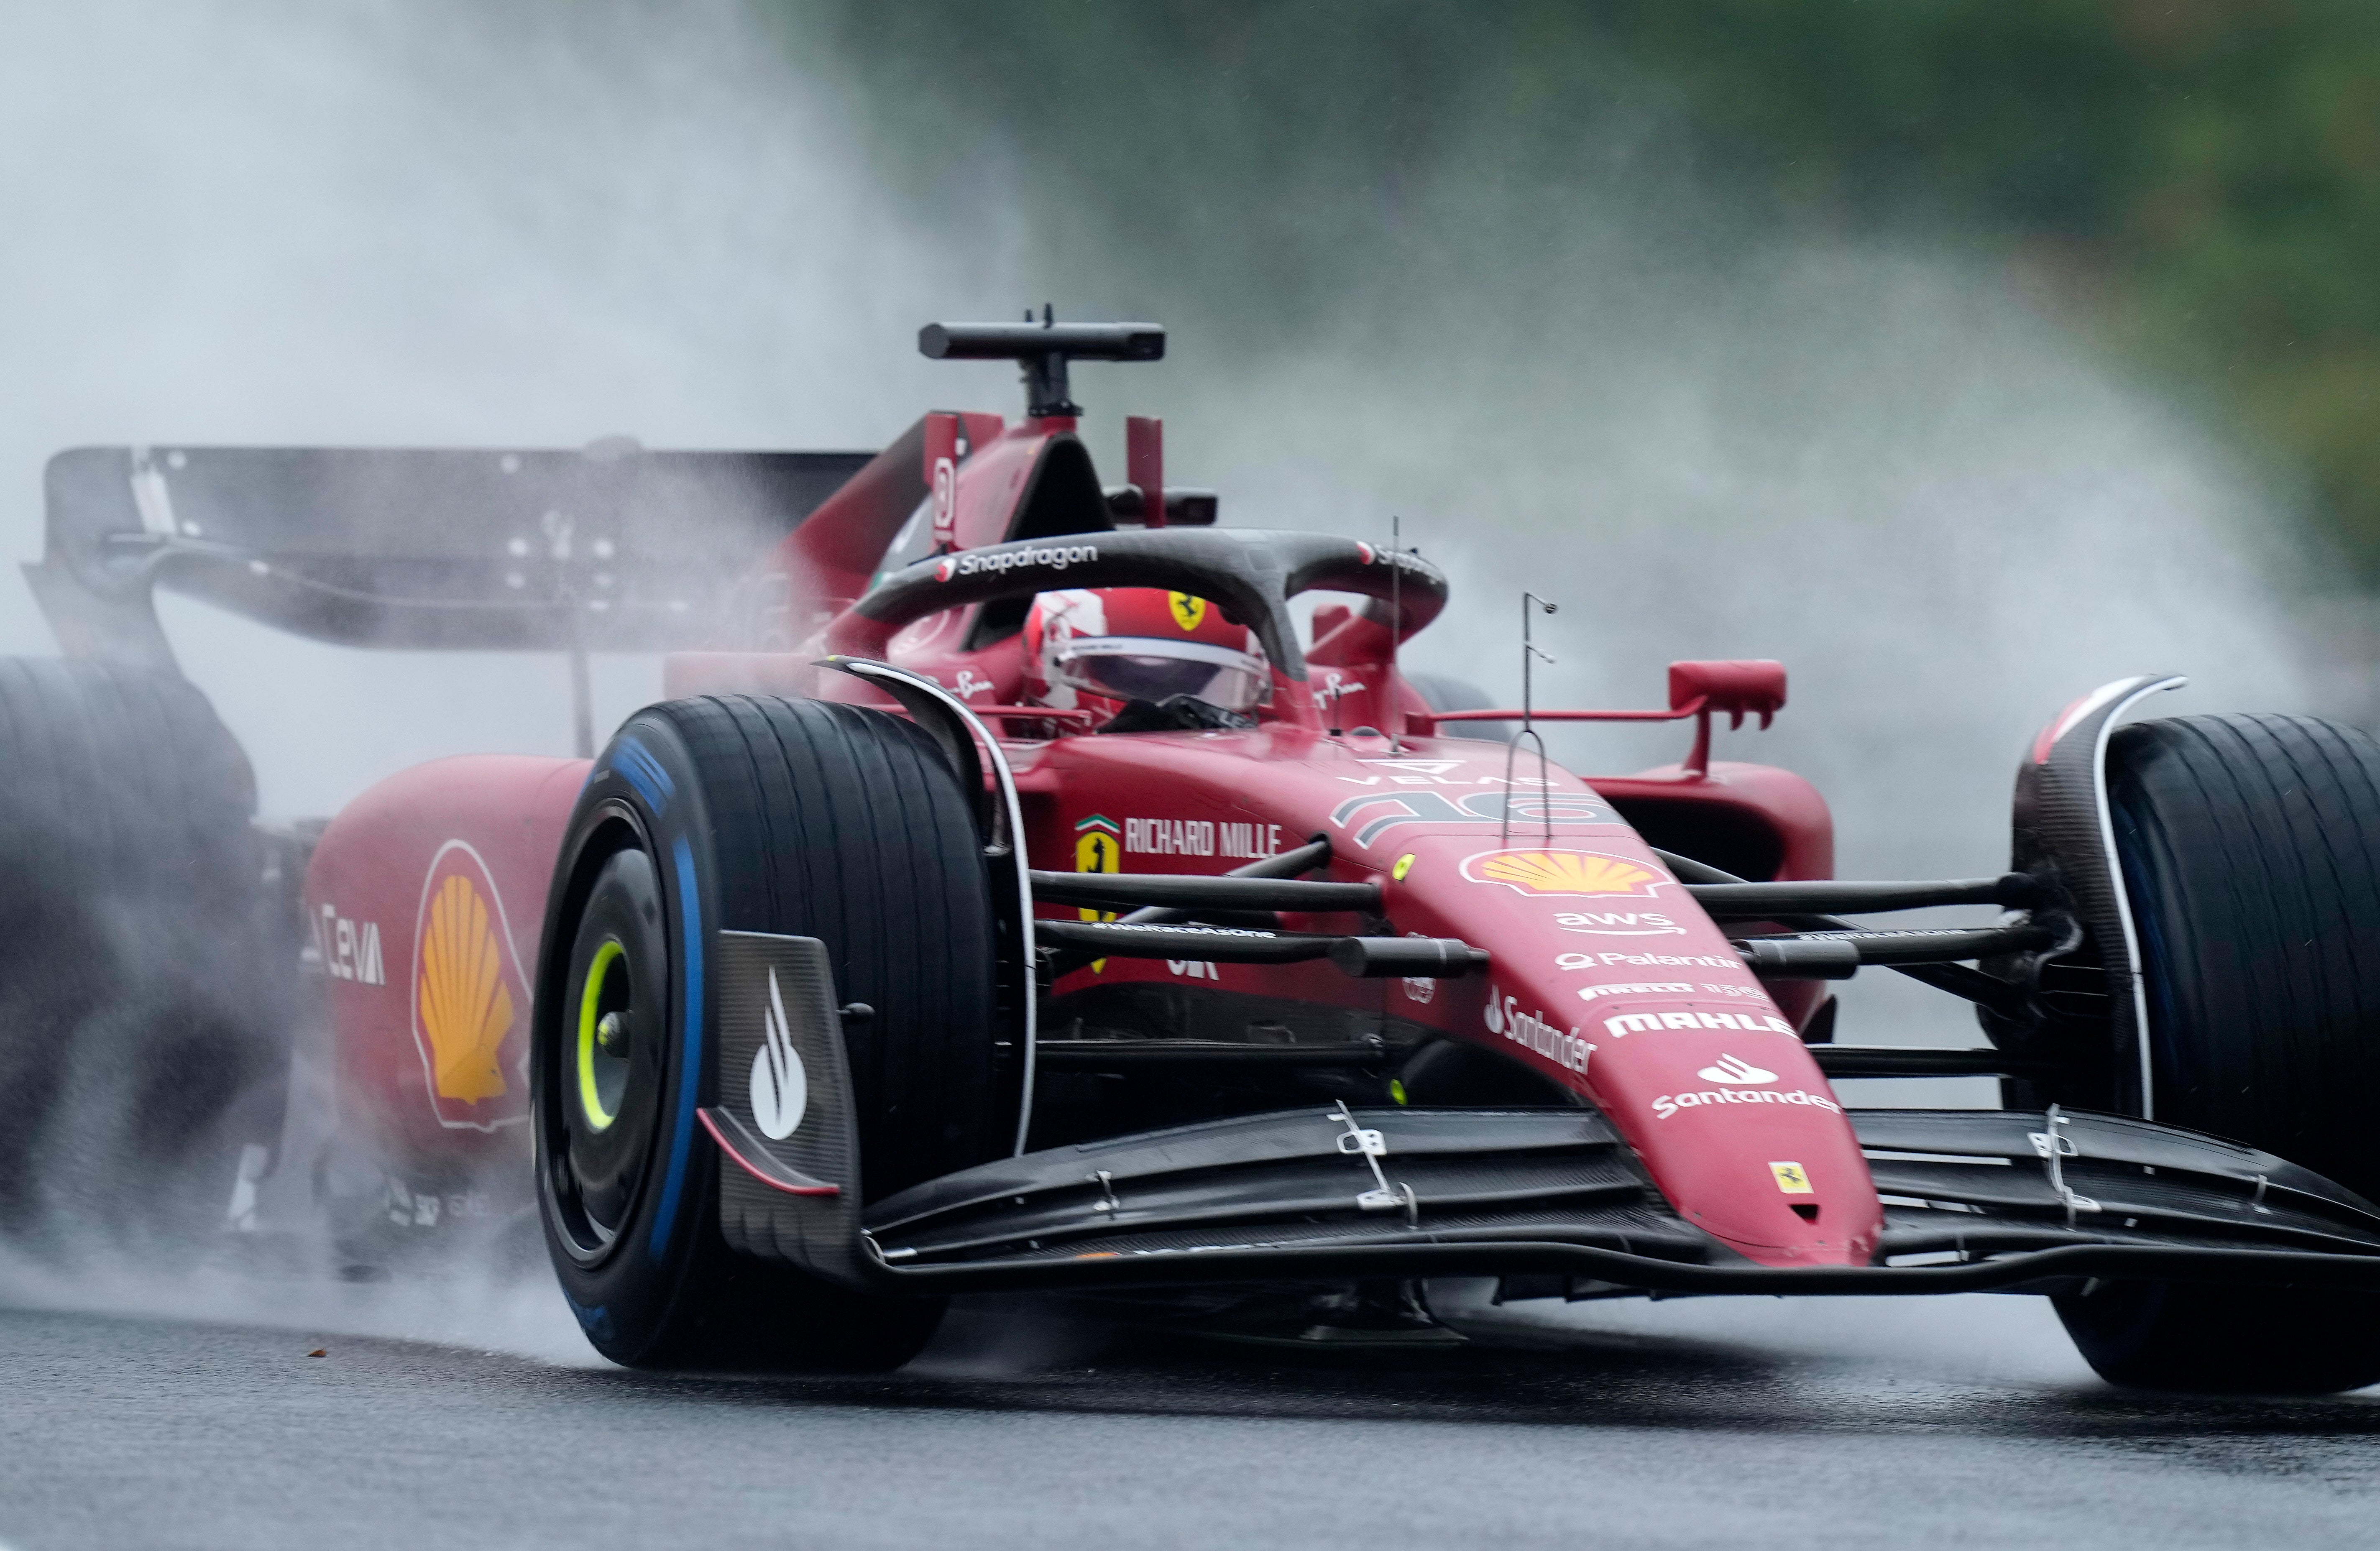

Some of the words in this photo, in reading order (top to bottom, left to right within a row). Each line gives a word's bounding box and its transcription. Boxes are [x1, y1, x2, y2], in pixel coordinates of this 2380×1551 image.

[958, 545, 1098, 575] Snapdragon
[1336, 776, 1560, 787] VELAS
[1329, 791, 1633, 850] 16
[1125, 818, 1214, 856] RICHARD
[1219, 821, 1283, 859] MILLE
[1552, 912, 1675, 926] aws
[1596, 952, 1742, 969] Palantir
[1576, 982, 1696, 1002] PIRELLI
[1503, 995, 1599, 1075] Santander
[1603, 1012, 1802, 1040] MAHLE
[1651, 1087, 1843, 1119] Santander
